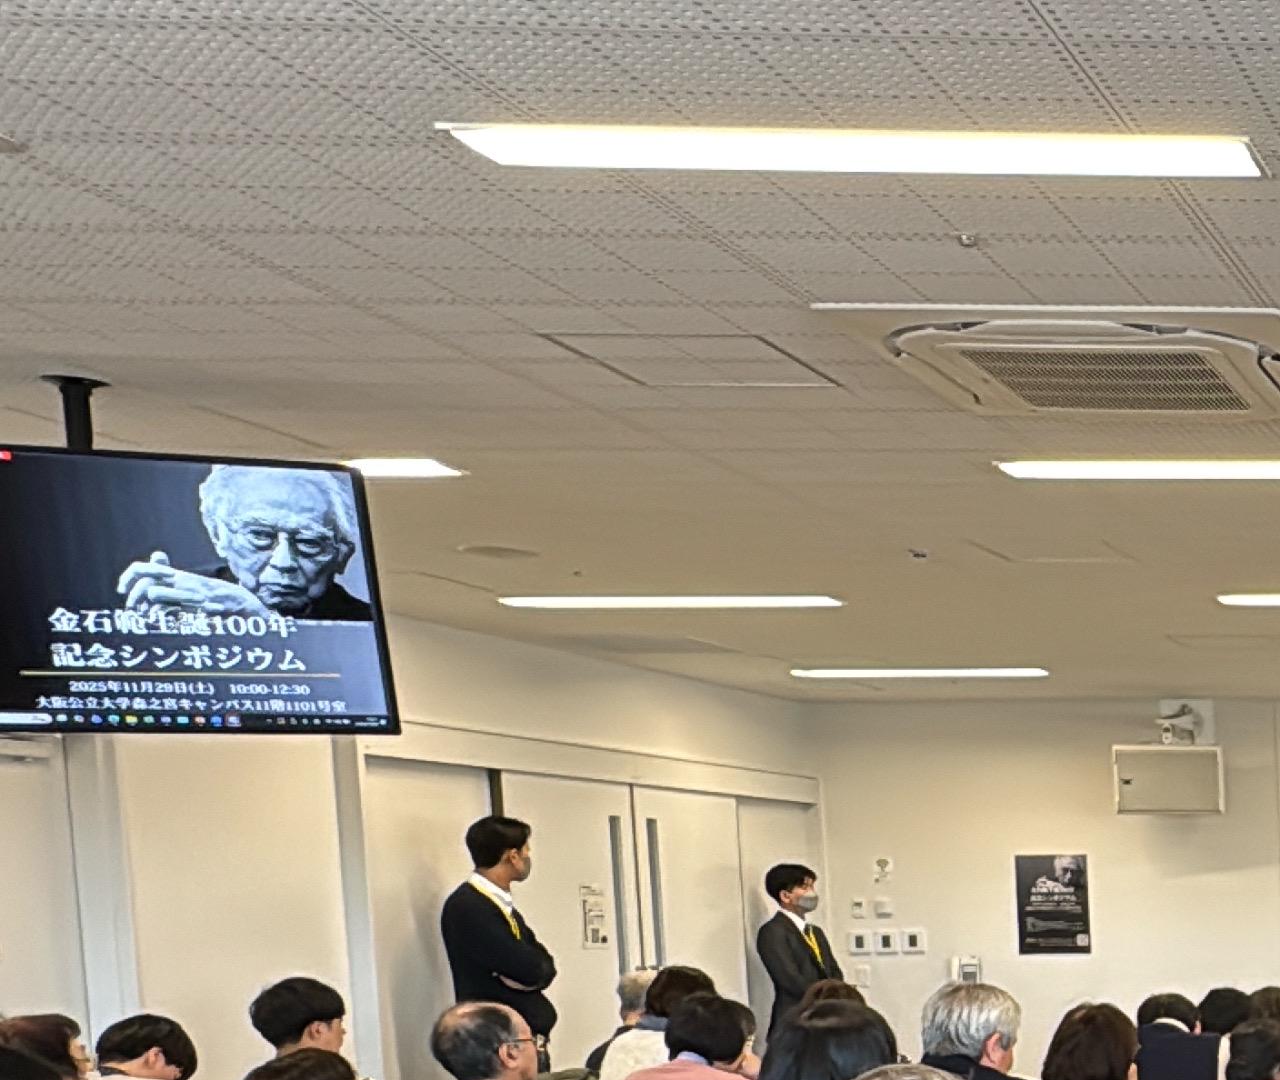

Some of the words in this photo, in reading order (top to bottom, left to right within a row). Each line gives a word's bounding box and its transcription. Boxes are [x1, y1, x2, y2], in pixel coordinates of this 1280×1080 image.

[48, 606, 298, 638] 金石範生誕100年
[50, 642, 307, 671] 記念シンポジウム
